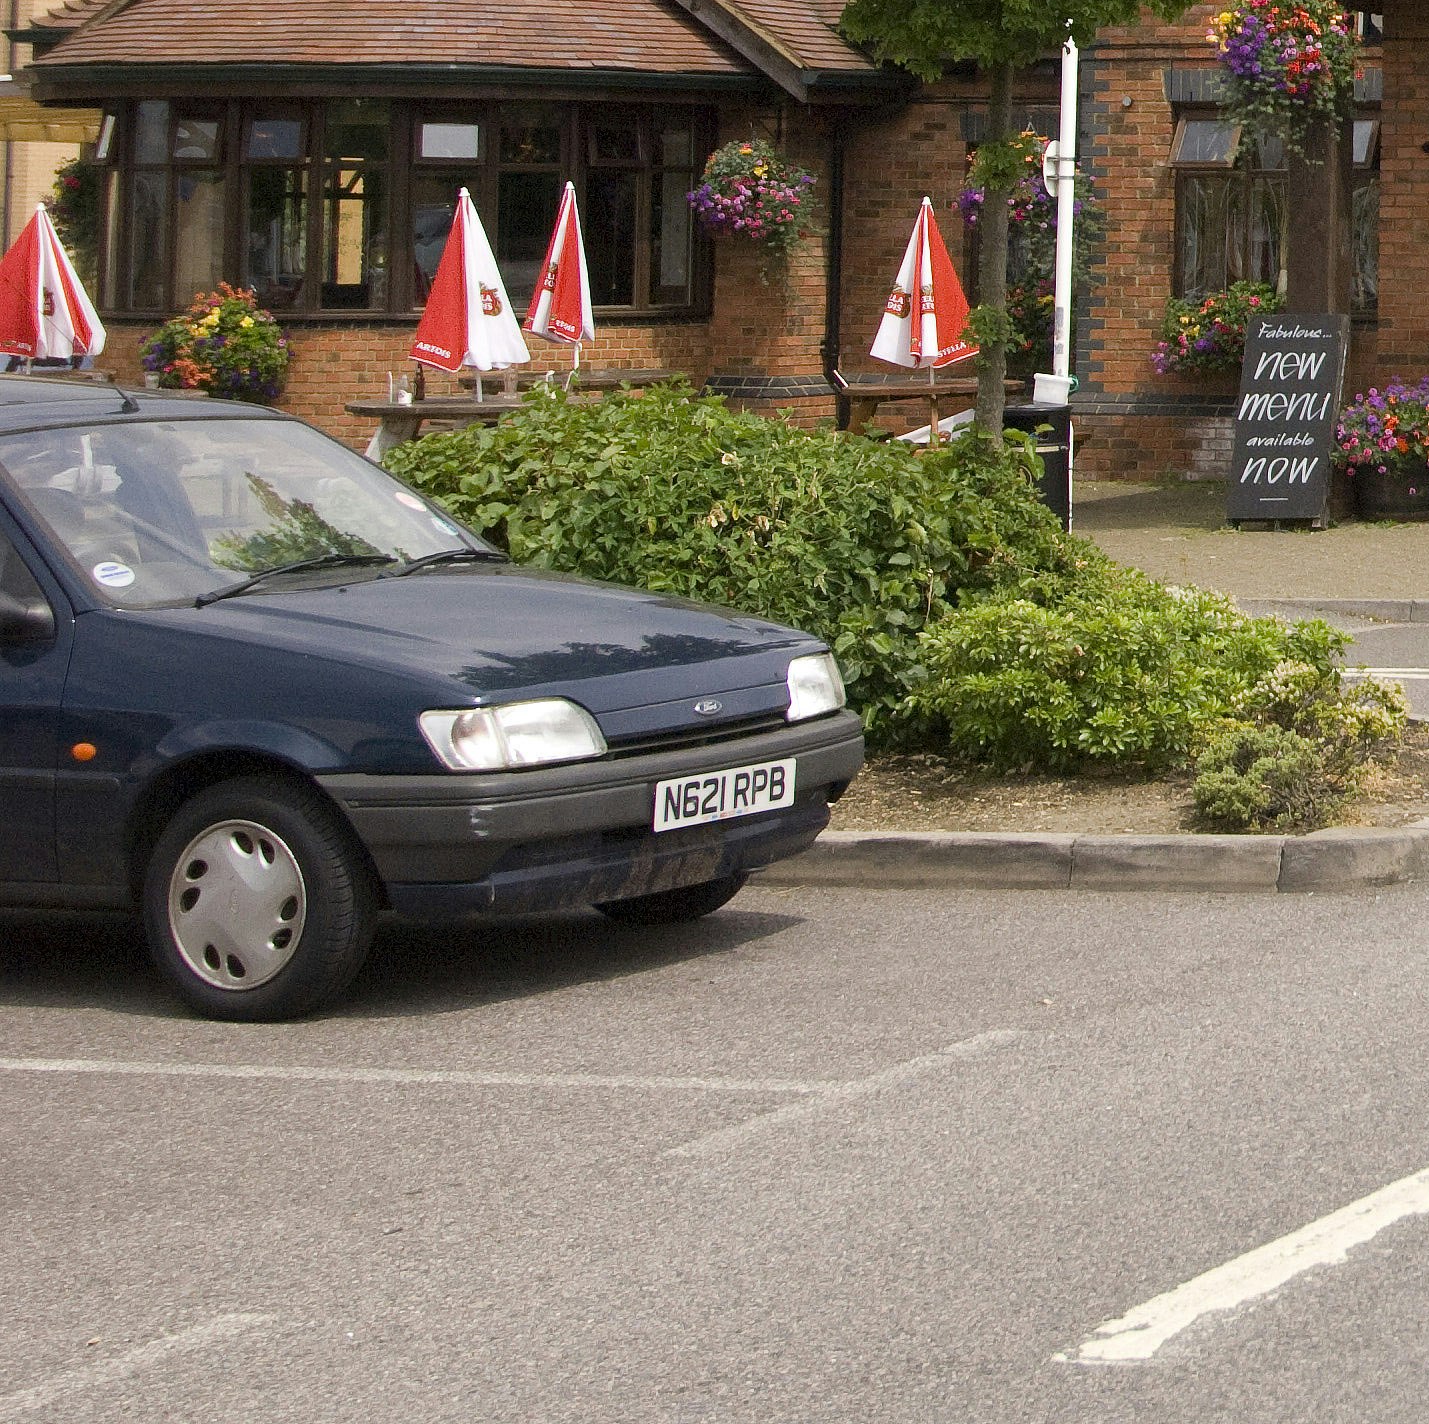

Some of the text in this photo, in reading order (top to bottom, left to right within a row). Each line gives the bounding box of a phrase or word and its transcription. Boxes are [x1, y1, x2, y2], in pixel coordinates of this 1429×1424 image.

[415, 342, 452, 359] ARTOIS
[1253, 351, 1327, 381] new
[1237, 392, 1332, 421] menu
[1246, 432, 1315, 447] available
[1240, 456, 1319, 485] now
[663, 765, 786, 824] N621 RPB
